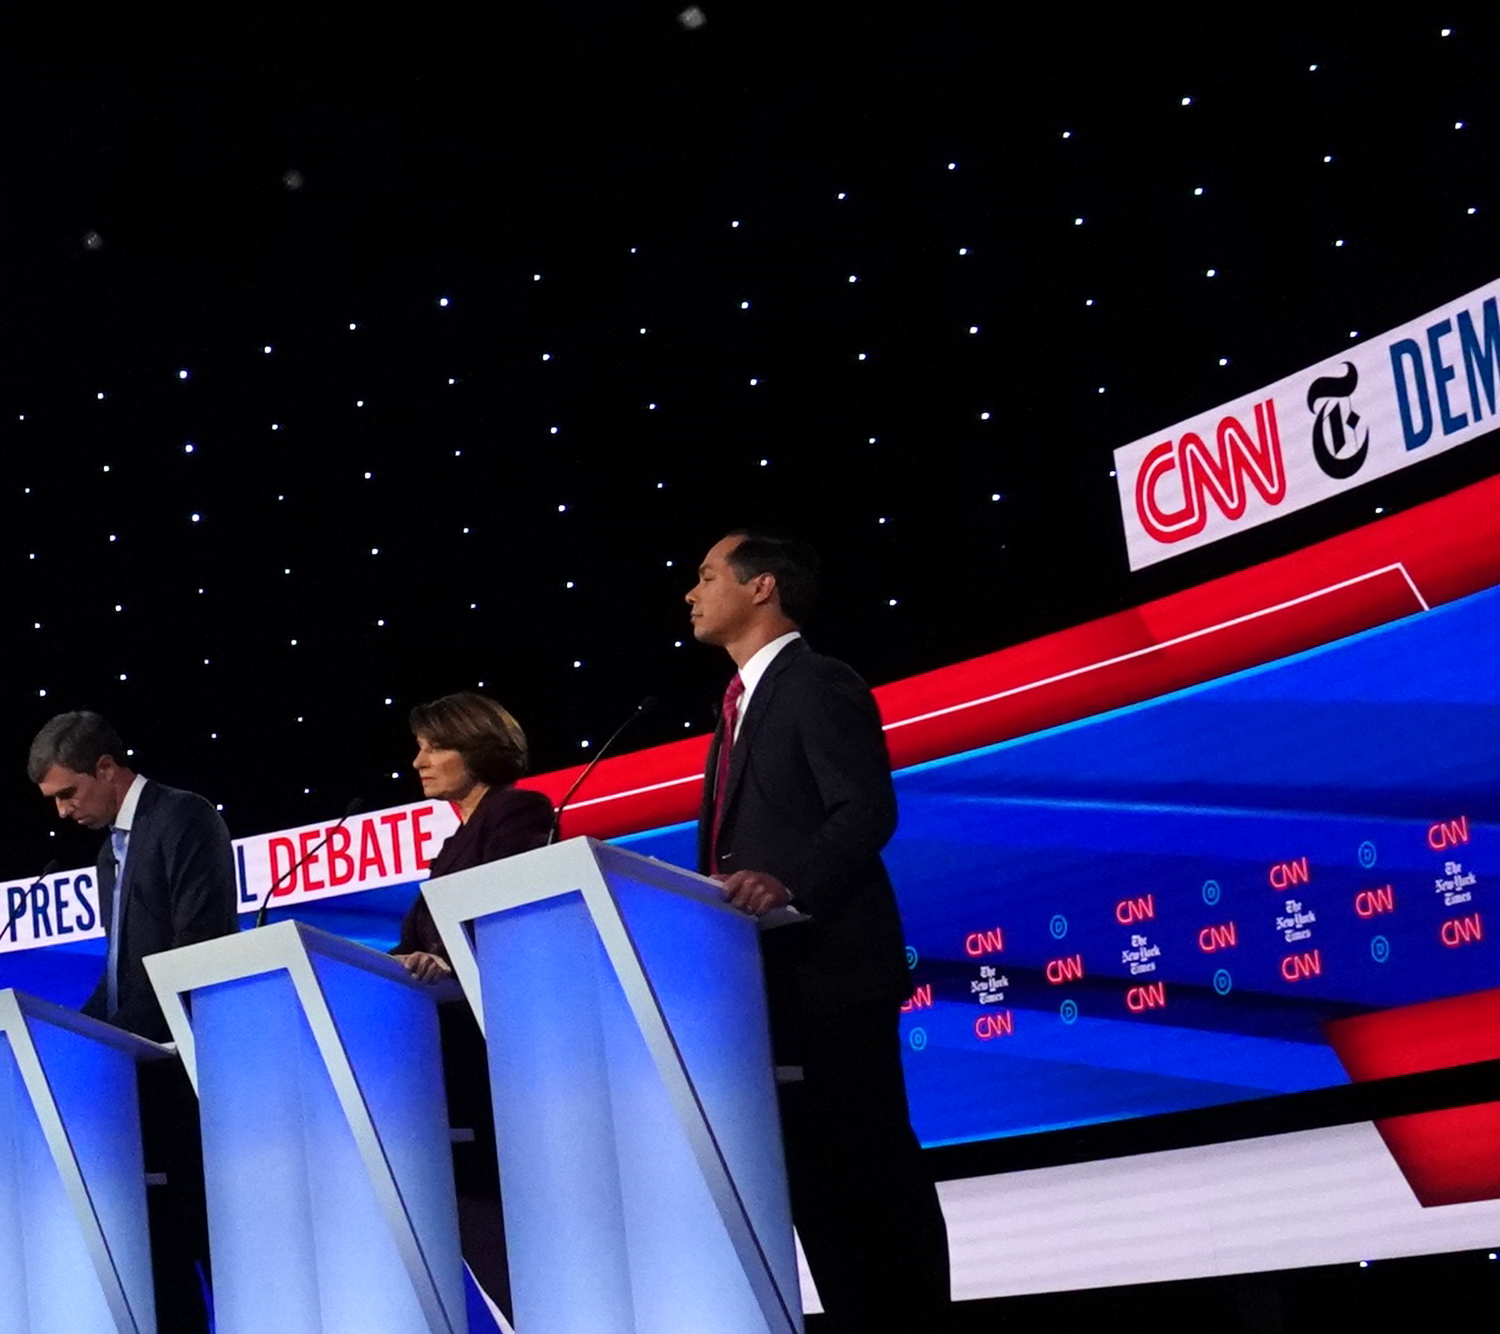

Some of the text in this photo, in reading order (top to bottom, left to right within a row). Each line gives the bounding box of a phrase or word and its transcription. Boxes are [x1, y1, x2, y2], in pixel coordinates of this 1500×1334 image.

[1135, 398, 1286, 544] CNN
[1428, 816, 1469, 850] CNN
[268, 806, 433, 898] DEBATE
[1270, 857, 1309, 890] CNN
[1116, 894, 1155, 925] CNN
[1356, 885, 1394, 918] CNN
[965, 927, 1004, 957] CNN
[1199, 921, 1237, 953] CNN
[1441, 913, 1482, 948] CNN
[1046, 954, 1084, 985] CNN
[1282, 949, 1321, 982] CNN
[1127, 981, 1165, 1013] CNN
[975, 1010, 1012, 1041] CNN
